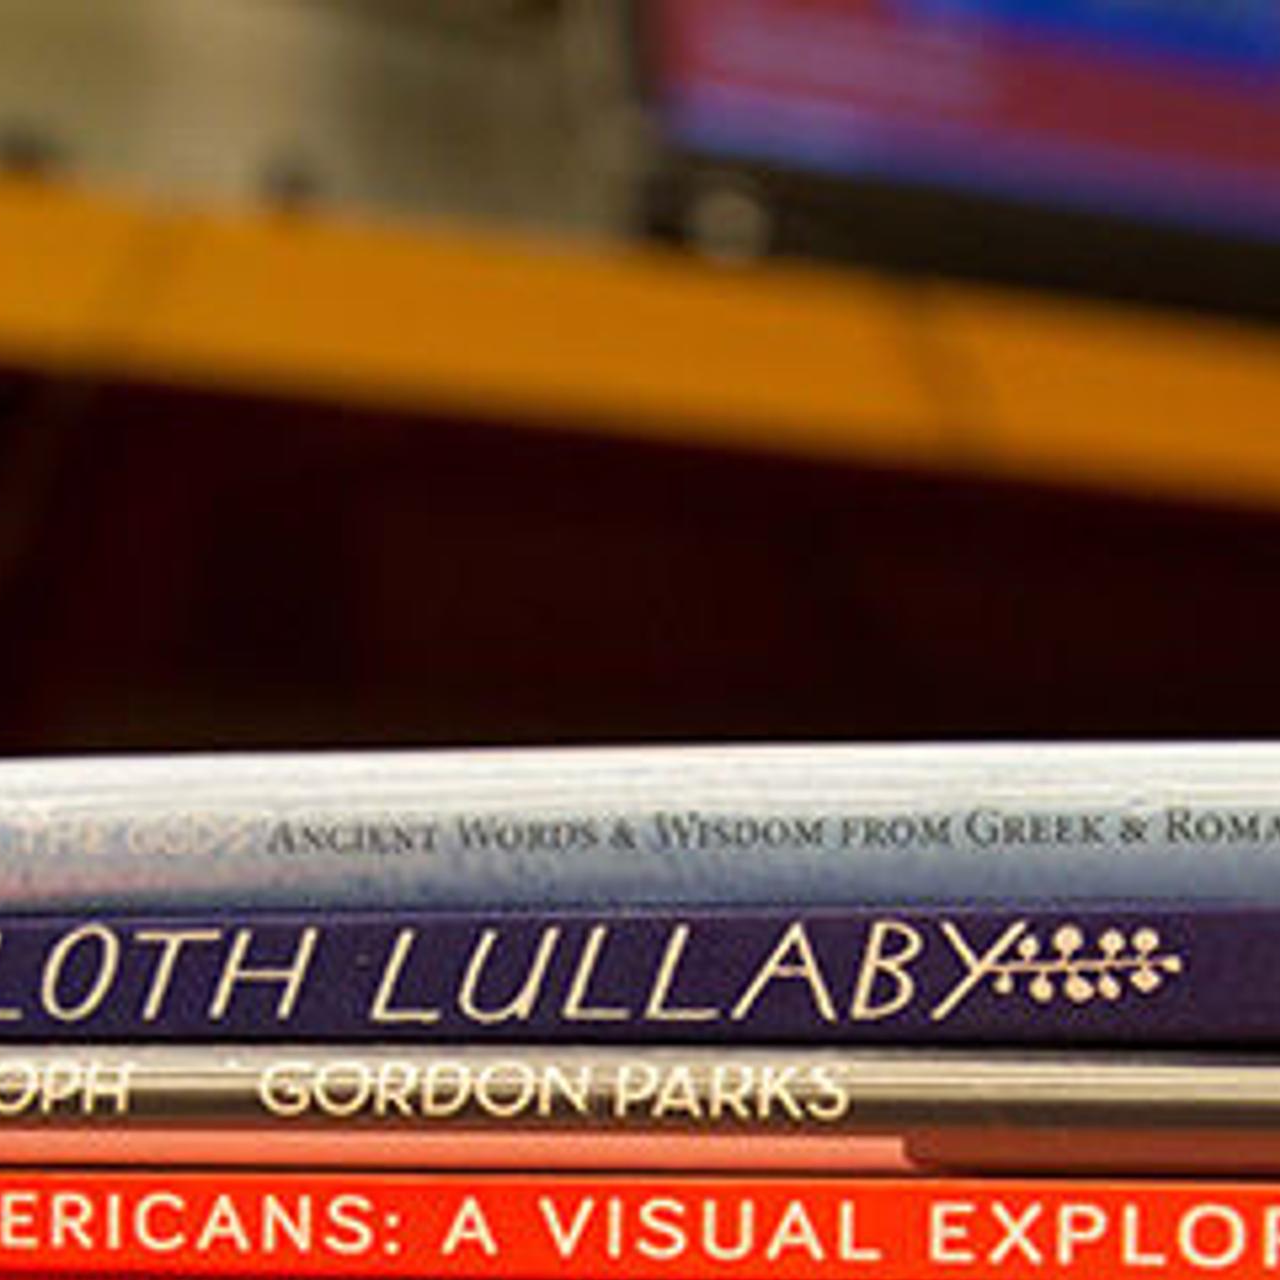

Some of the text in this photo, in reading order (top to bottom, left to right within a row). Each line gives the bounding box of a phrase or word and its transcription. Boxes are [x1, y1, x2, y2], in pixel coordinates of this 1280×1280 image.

[368, 920, 1028, 1024] LULLABY
[257, 1060, 852, 1120] GORDON PARKS
[441, 1196, 498, 1257] A
[538, 1196, 884, 1264] VISUAL
